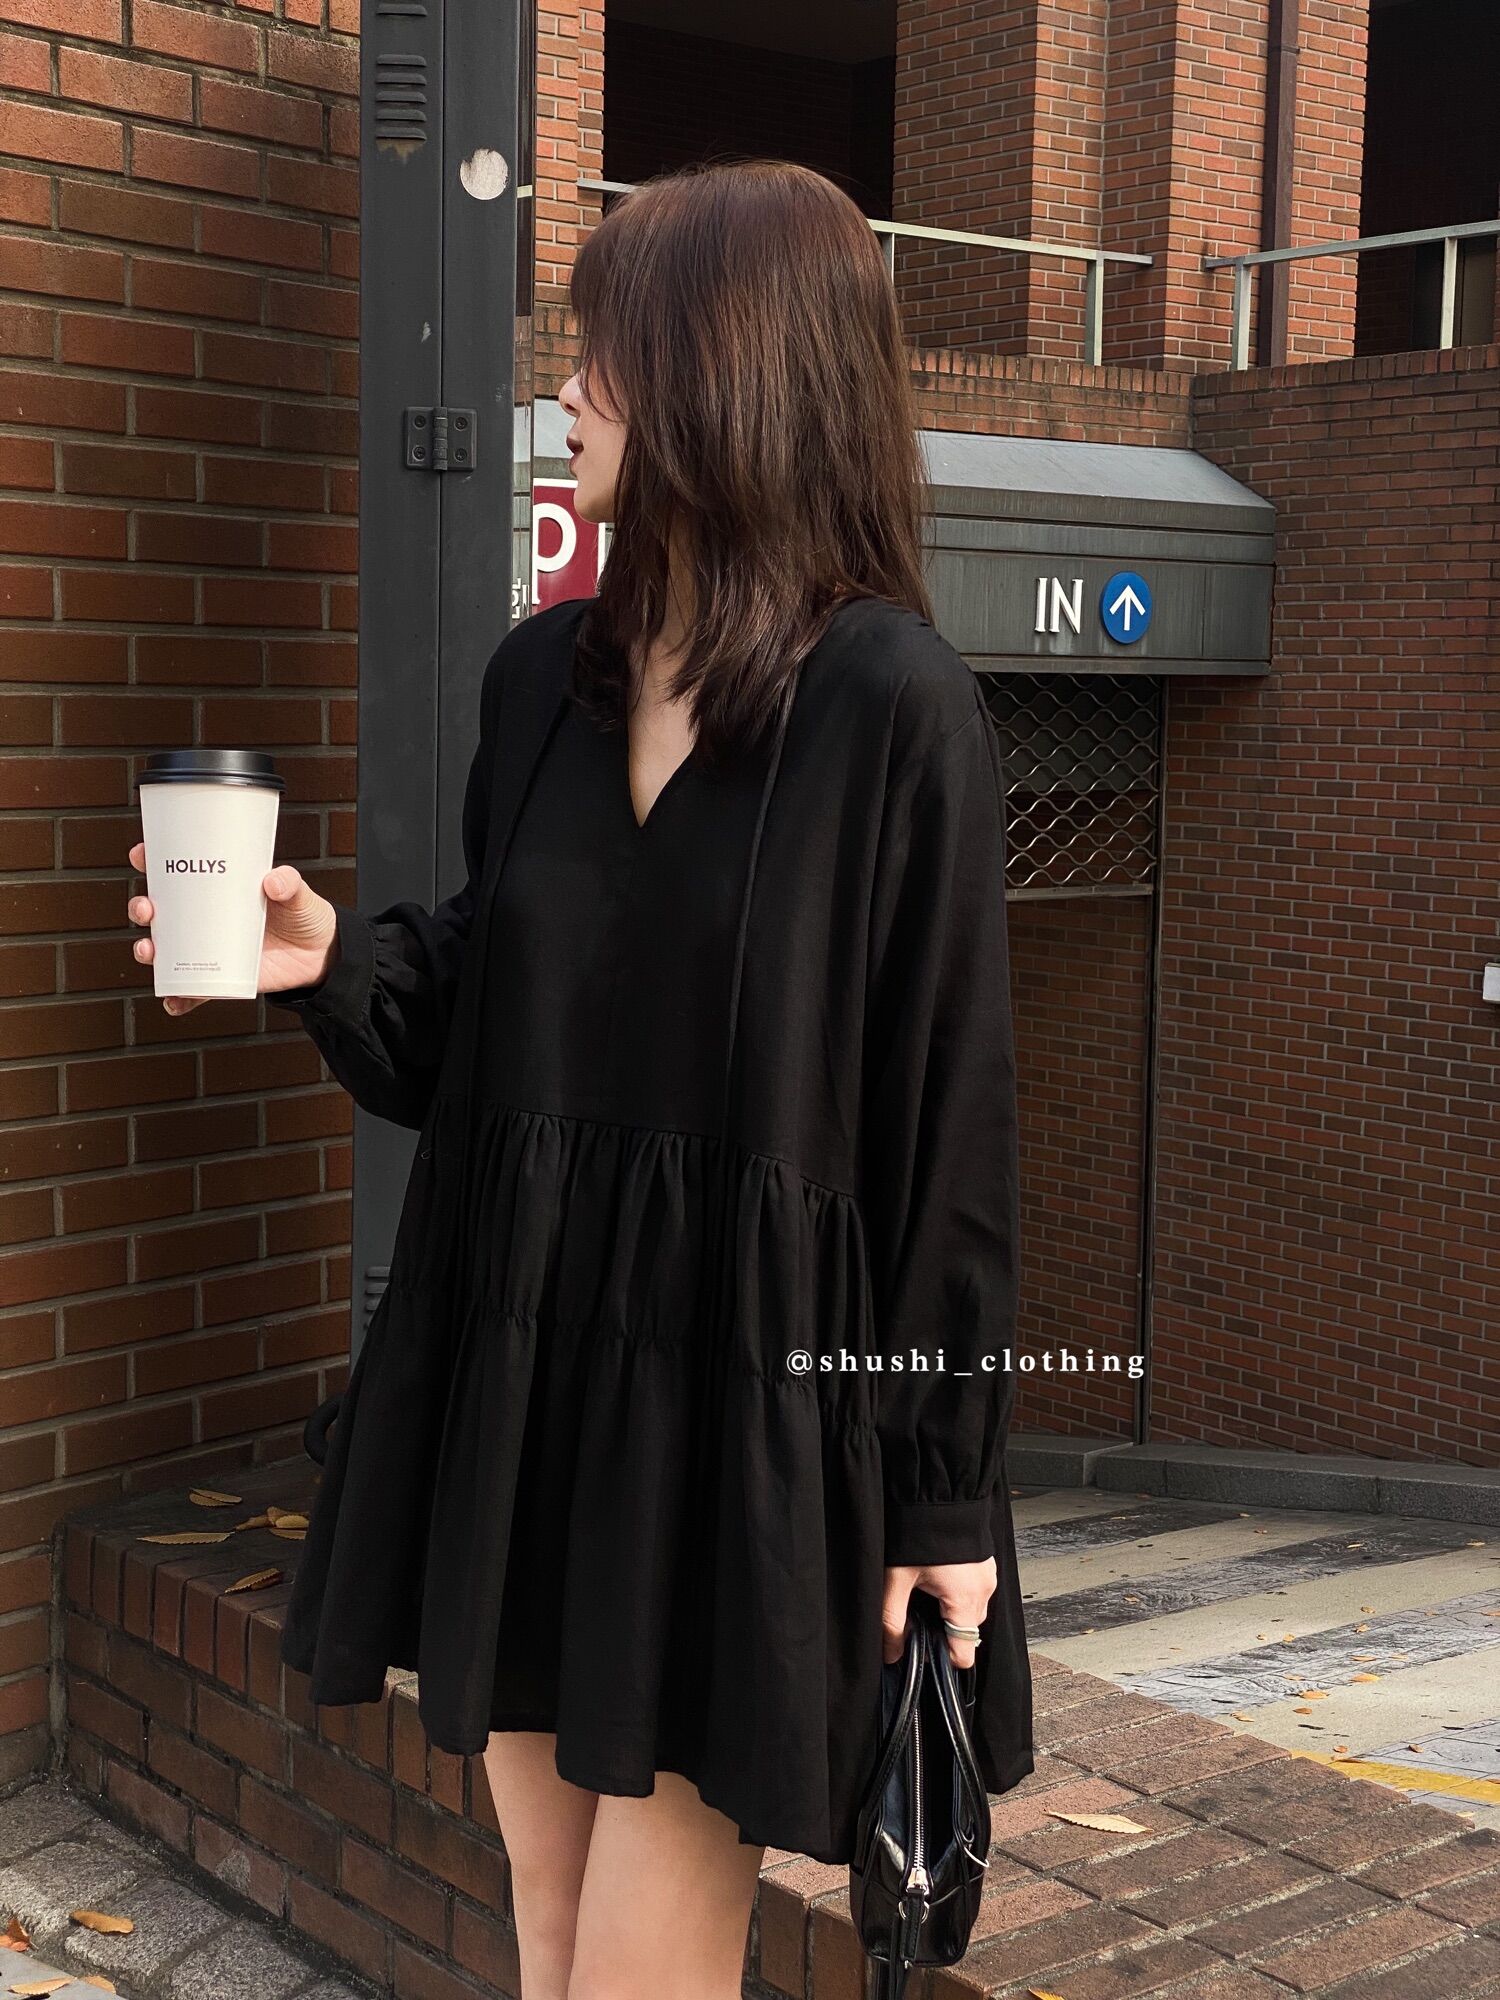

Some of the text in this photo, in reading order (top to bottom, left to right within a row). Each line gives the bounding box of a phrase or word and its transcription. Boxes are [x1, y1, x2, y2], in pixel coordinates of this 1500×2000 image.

[532, 502, 577, 604] P
[1034, 577, 1083, 634] IN
[165, 859, 226, 873] HOLLYS
